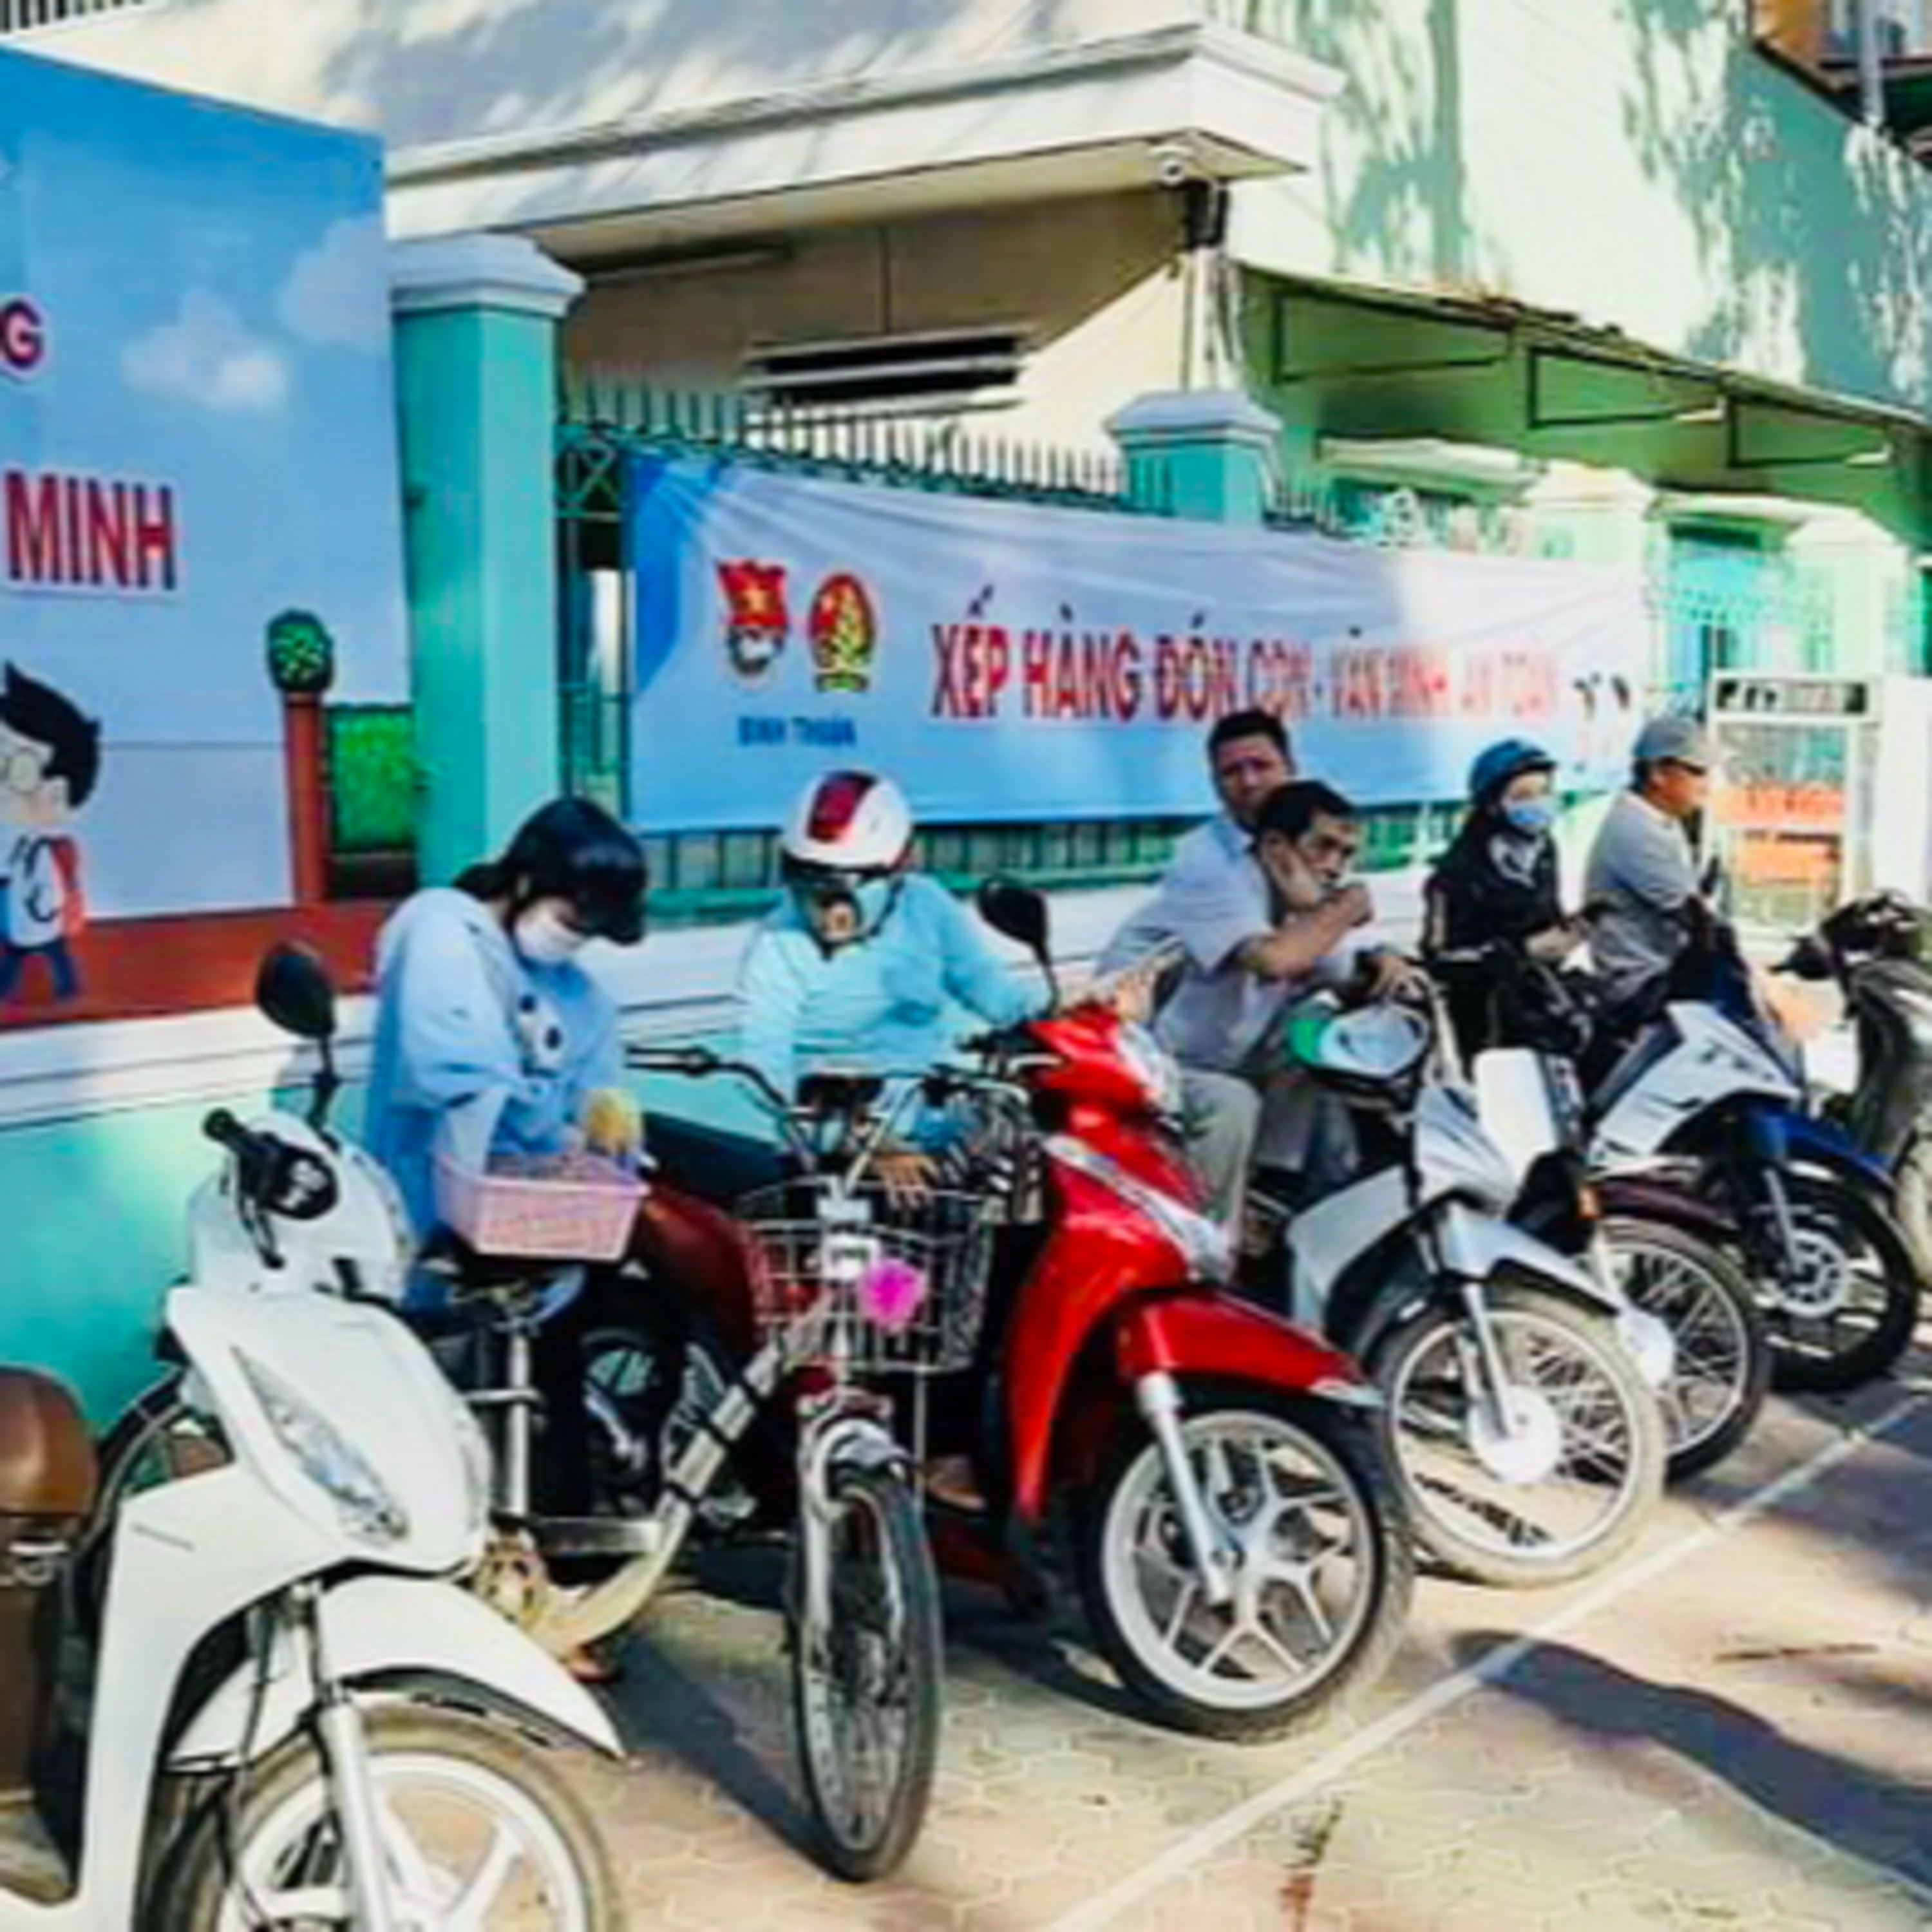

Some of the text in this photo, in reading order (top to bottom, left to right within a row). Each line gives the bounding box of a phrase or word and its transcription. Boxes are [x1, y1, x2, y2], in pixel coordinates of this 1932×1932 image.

[5, 470, 176, 591] MINH
[930, 583, 1010, 719] XẾP
[1022, 601, 1142, 723] HÀNG
